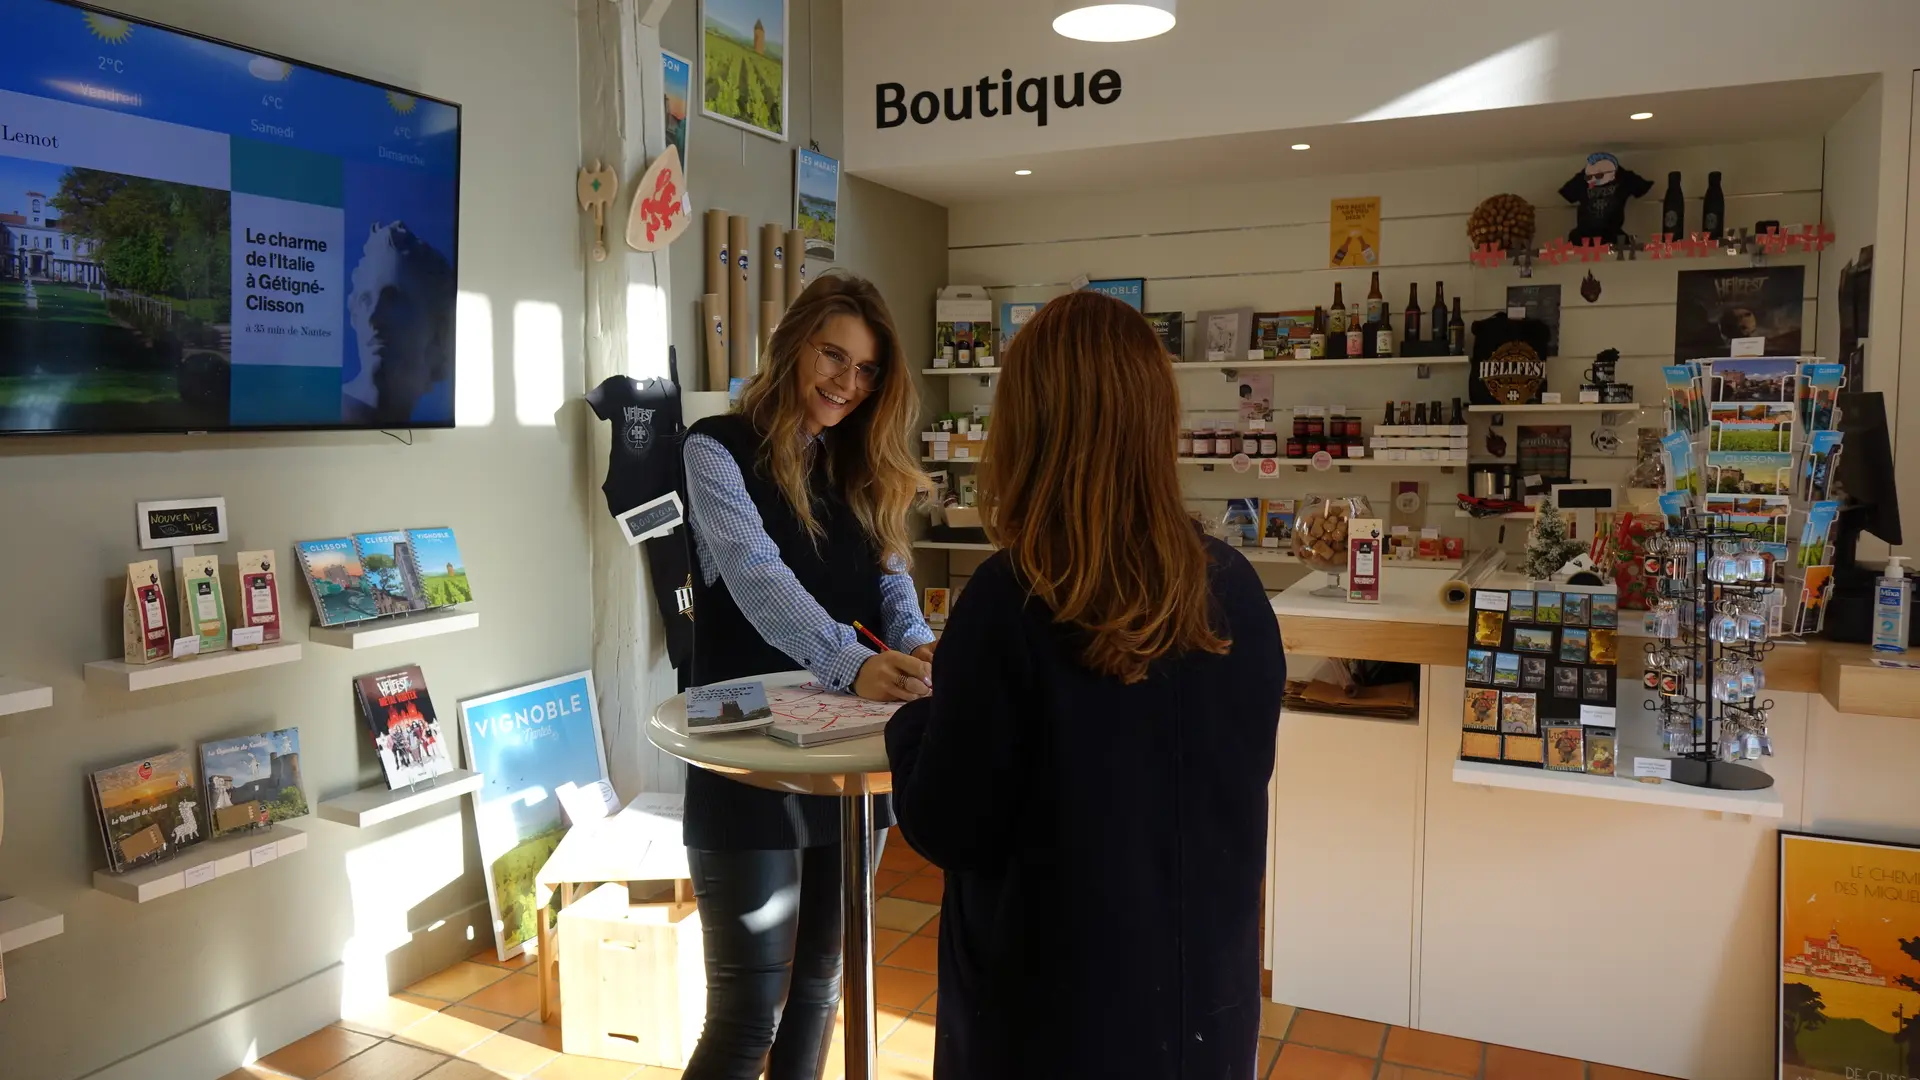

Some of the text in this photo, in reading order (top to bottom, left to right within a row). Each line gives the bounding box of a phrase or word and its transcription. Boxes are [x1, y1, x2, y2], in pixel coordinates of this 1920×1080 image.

[98, 56, 124, 74] 2°C
[80, 82, 142, 106] Vendredi
[262, 94, 283, 110] 4°C
[876, 68, 1122, 129] Boutique
[2, 125, 59, 148] Lemot
[251, 119, 295, 139] Samedi
[379, 146, 425, 166] Dimanche
[813, 159, 837, 174] MARAIS
[246, 227, 327, 253] Le charme
[246, 251, 315, 272] de l'Italie
[246, 272, 325, 295] à Gétigné-
[246, 295, 304, 313] Clisson
[245, 323, 332, 337] à 35 min de Nantes
[1479, 361, 1546, 379] HELLFEST
[1724, 455, 1776, 464] CLISSON
[310, 542, 348, 552] CLISSON
[364, 535, 401, 544] CLISSON
[1880, 589, 1900, 597] Mixa
[475, 694, 581, 738] VIGNOBLE
[1851, 866, 1863, 879] LE
[1834, 880, 1858, 896] DES
[1845, 1066, 1862, 1080] DE
